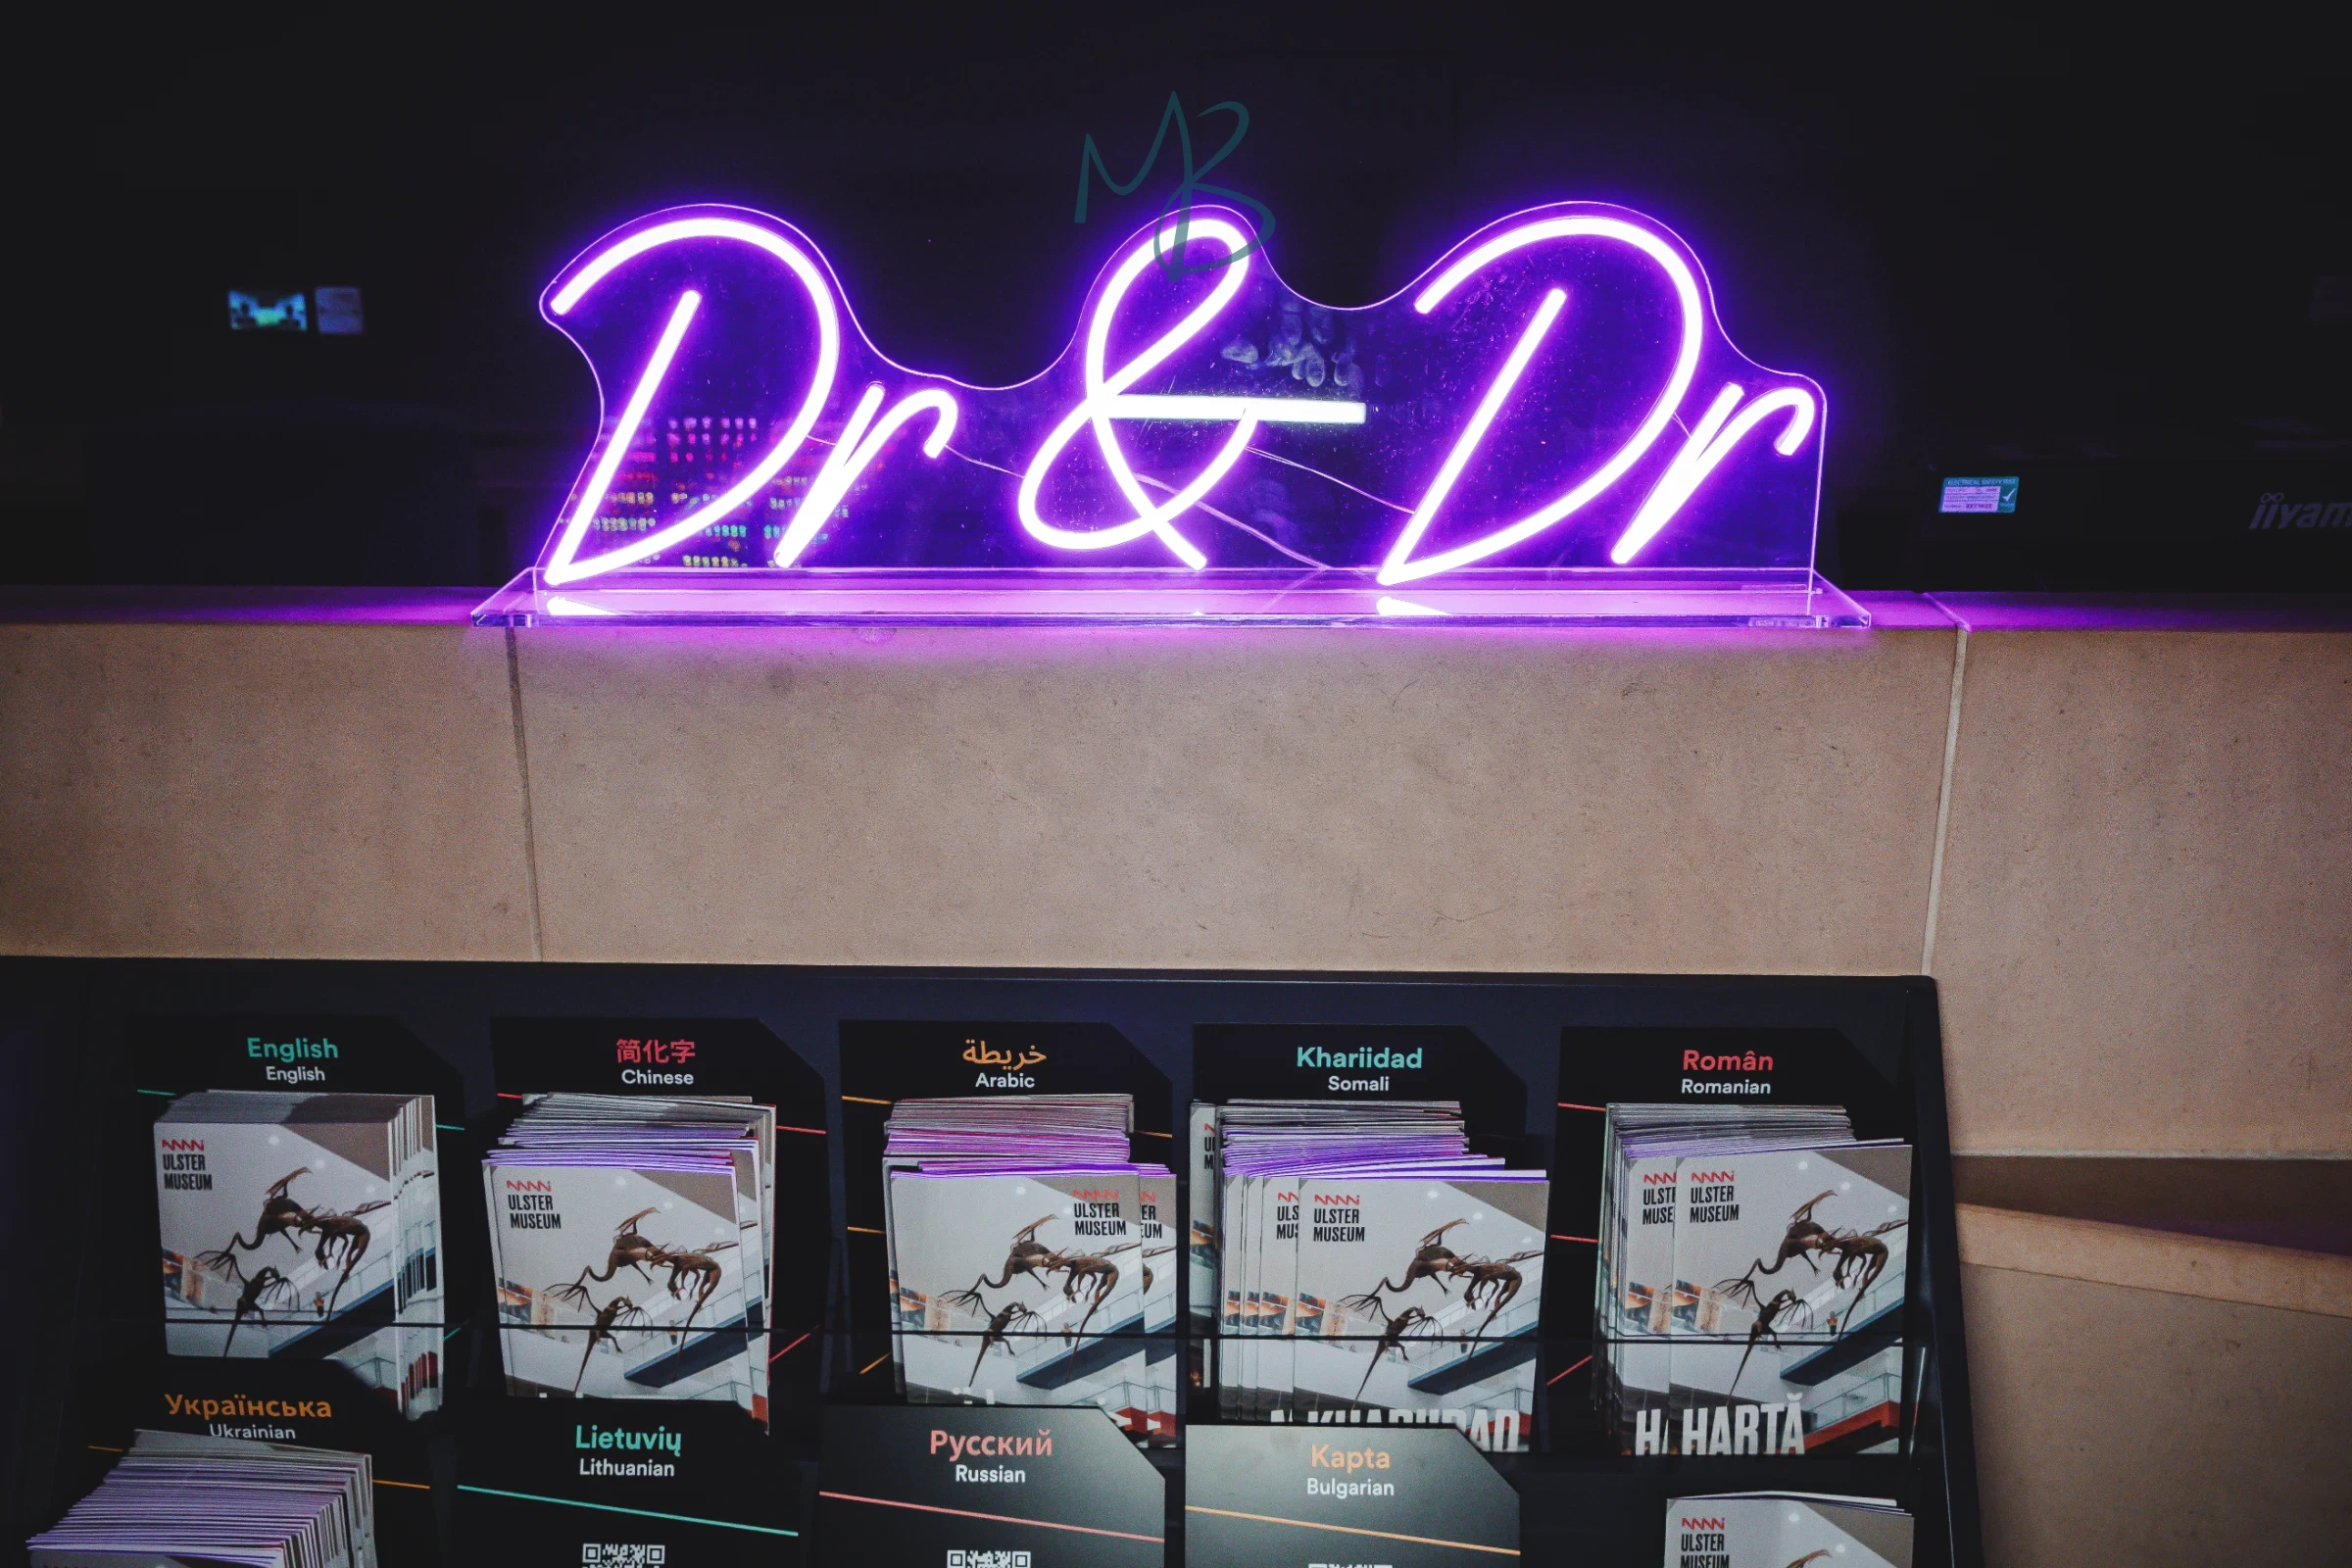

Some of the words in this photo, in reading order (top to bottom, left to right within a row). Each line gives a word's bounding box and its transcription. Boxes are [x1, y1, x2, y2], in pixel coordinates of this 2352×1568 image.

[544, 216, 959, 585] Dr
[1017, 217, 1367, 571] &
[1376, 215, 1816, 587] Dr
[247, 1037, 339, 1064] English
[615, 1038, 696, 1064] 简化字
[962, 1039, 1048, 1071] خريطة
[1297, 1046, 1423, 1069] Khariidad
[1683, 1049, 1774, 1071] Român
[266, 1065, 326, 1084] English
[620, 1068, 695, 1085] Chinese
[975, 1072, 1036, 1089] Arabic
[1327, 1075, 1390, 1092] Somali
[1681, 1078, 1772, 1095] Romanian
[163, 1153, 206, 1171] ULSTER
[164, 1173, 213, 1191] MUSEUM
[508, 1195, 554, 1211] ULSTER
[1690, 1185, 1735, 1204] ULSTER
[1073, 1201, 1120, 1218] ULSTER
[1313, 1207, 1360, 1224] ULSTER
[1690, 1203, 1740, 1224] MUSEUM
[510, 1213, 562, 1230] MUSEUM
[1074, 1220, 1127, 1237] MUSEUM
[1313, 1226, 1366, 1243] MUSEUM
[165, 1394, 332, 1421] Українська
[209, 1423, 296, 1441] Ukrainian
[1681, 1393, 1805, 1456] HARTĂ
[575, 1424, 682, 1457] Lietuvių
[930, 1428, 1054, 1462] Русский
[579, 1457, 675, 1477] Lithuanian
[955, 1463, 1026, 1484] Russian
[1306, 1477, 1395, 1499] Bulgarian
[1681, 1533, 1725, 1551] ULSTER
